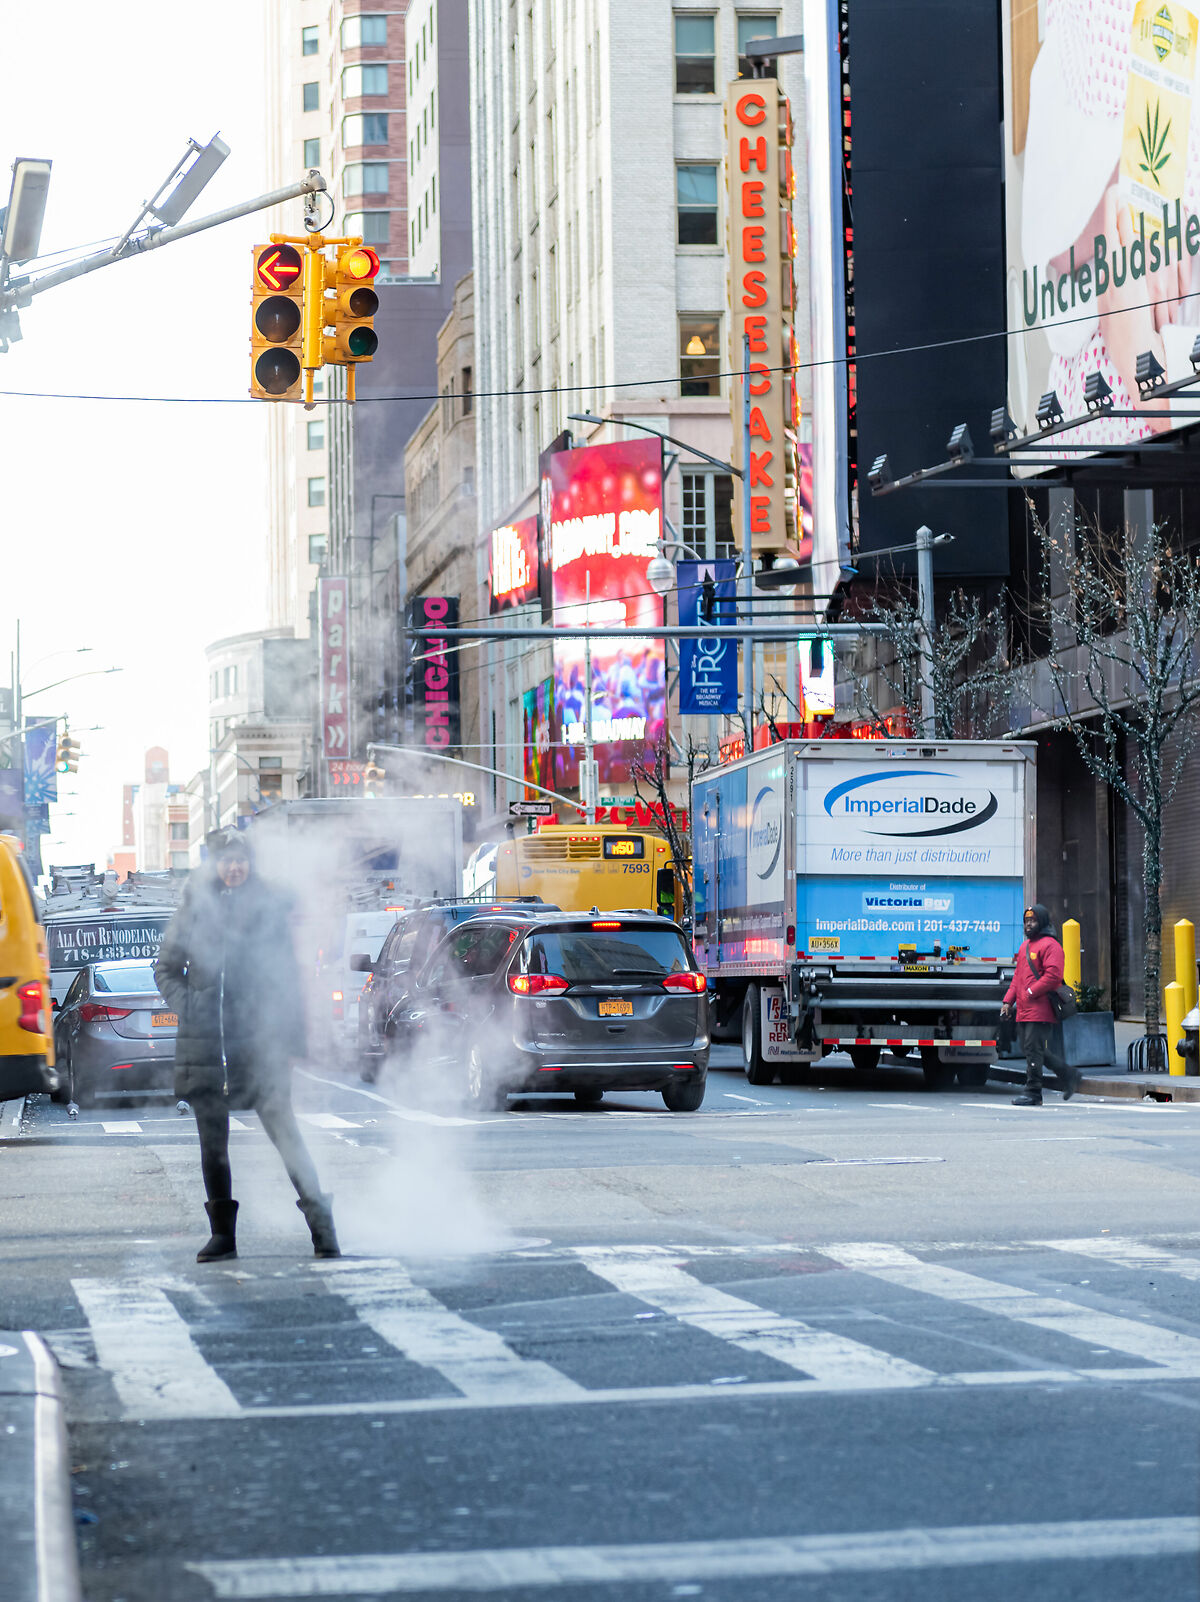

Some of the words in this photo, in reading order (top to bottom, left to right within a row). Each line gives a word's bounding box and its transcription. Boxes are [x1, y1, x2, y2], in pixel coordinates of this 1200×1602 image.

[736, 93, 774, 532] CHEESECAKE
[327, 589, 344, 714] park
[423, 597, 451, 751] CHICAGO
[610, 801, 677, 827] CVS
[845, 796, 977, 816] ImperialDade
[831, 848, 863, 862] More
[865, 848, 892, 862] than
[894, 849, 918, 863] just
[920, 849, 991, 863] distribution!
[622, 864, 650, 874] 7593
[889, 883, 919, 891] Distributor
[865, 897, 922, 906] Victoria
[924, 898, 951, 911] Bay
[815, 918, 915, 932] ImperialDade.com
[923, 919, 1001, 933] 201-437-7440
